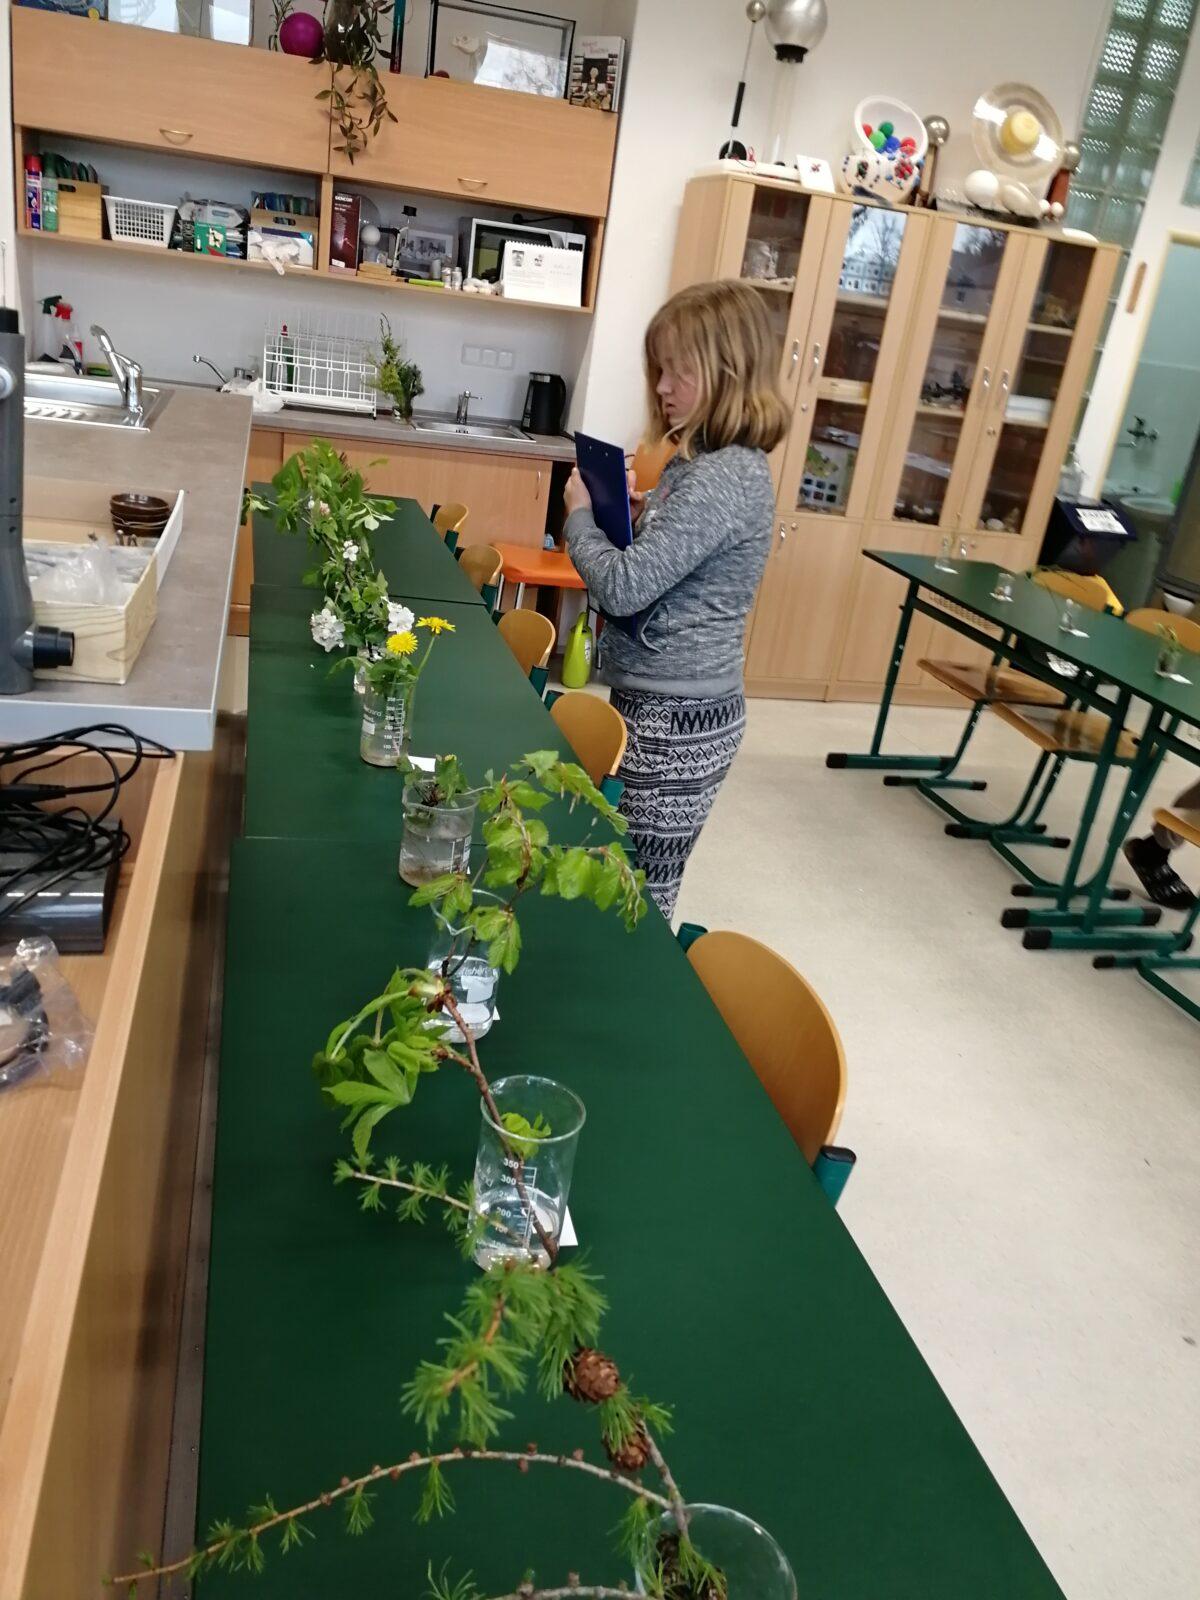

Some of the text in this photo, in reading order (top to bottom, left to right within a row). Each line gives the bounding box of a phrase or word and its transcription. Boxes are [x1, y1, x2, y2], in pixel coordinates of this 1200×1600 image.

[504, 1158, 519, 1169] 350
[500, 1174, 516, 1185] 300
[496, 1207, 512, 1218] 200
